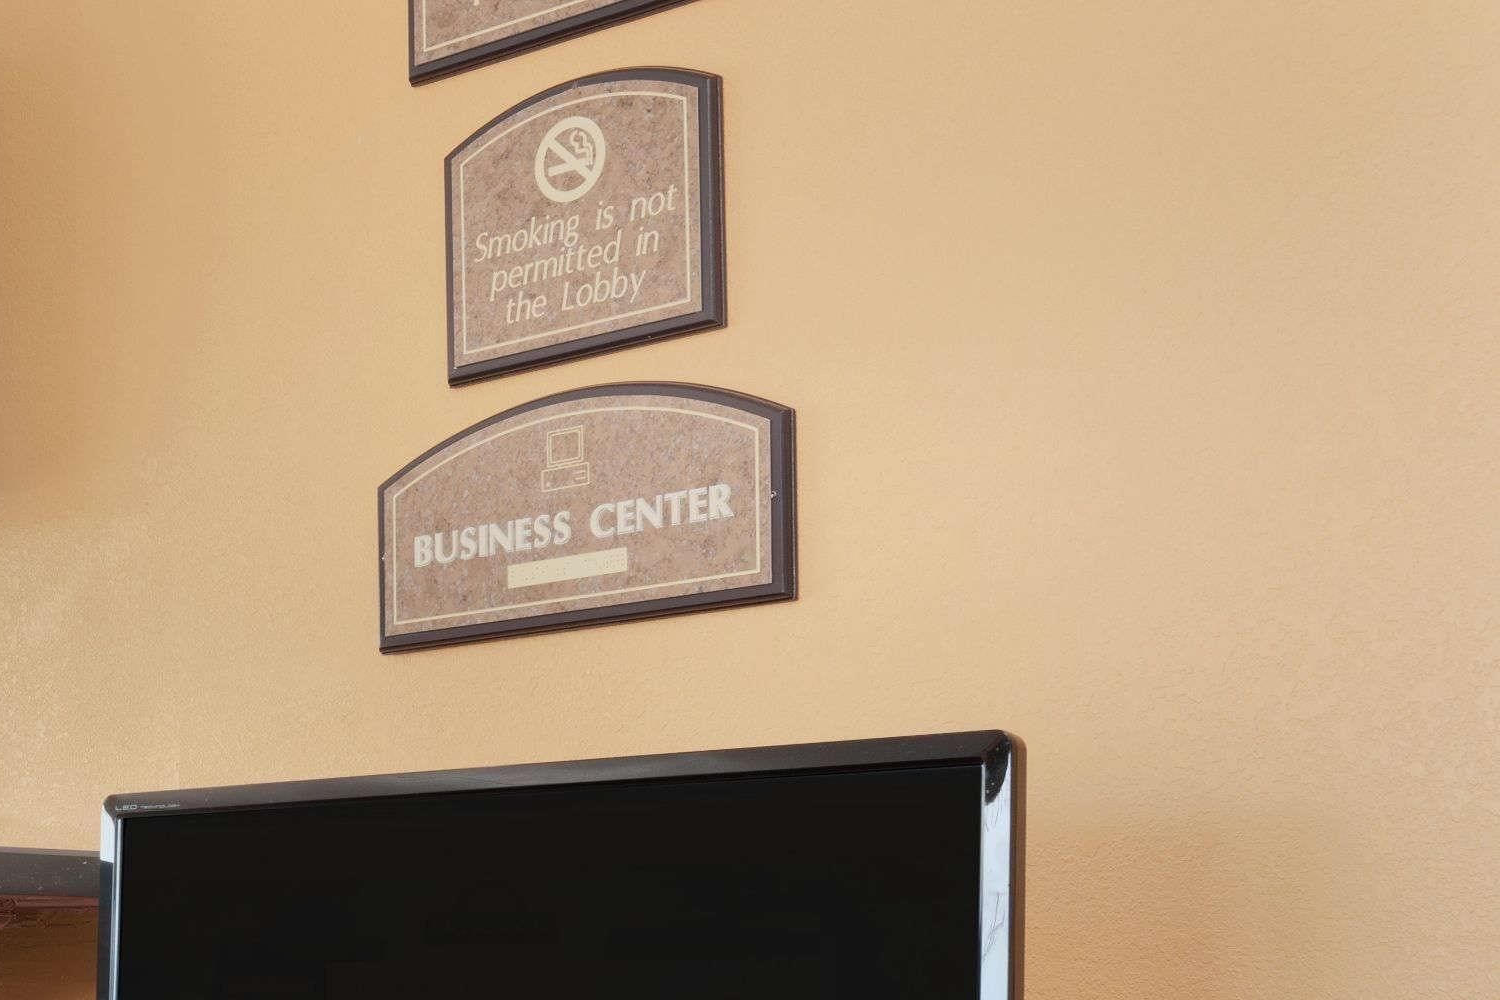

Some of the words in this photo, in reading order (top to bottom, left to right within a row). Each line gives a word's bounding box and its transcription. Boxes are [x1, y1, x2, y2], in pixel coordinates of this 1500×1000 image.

[475, 215, 580, 263] Smoking
[595, 201, 614, 231] is
[630, 184, 678, 222] not
[490, 229, 622, 302] permitted
[636, 227, 660, 257] in
[506, 291, 547, 324] the
[561, 267, 646, 312] Lobby
[414, 510, 572, 568] BUSINESS
[590, 482, 735, 539] CENTER
